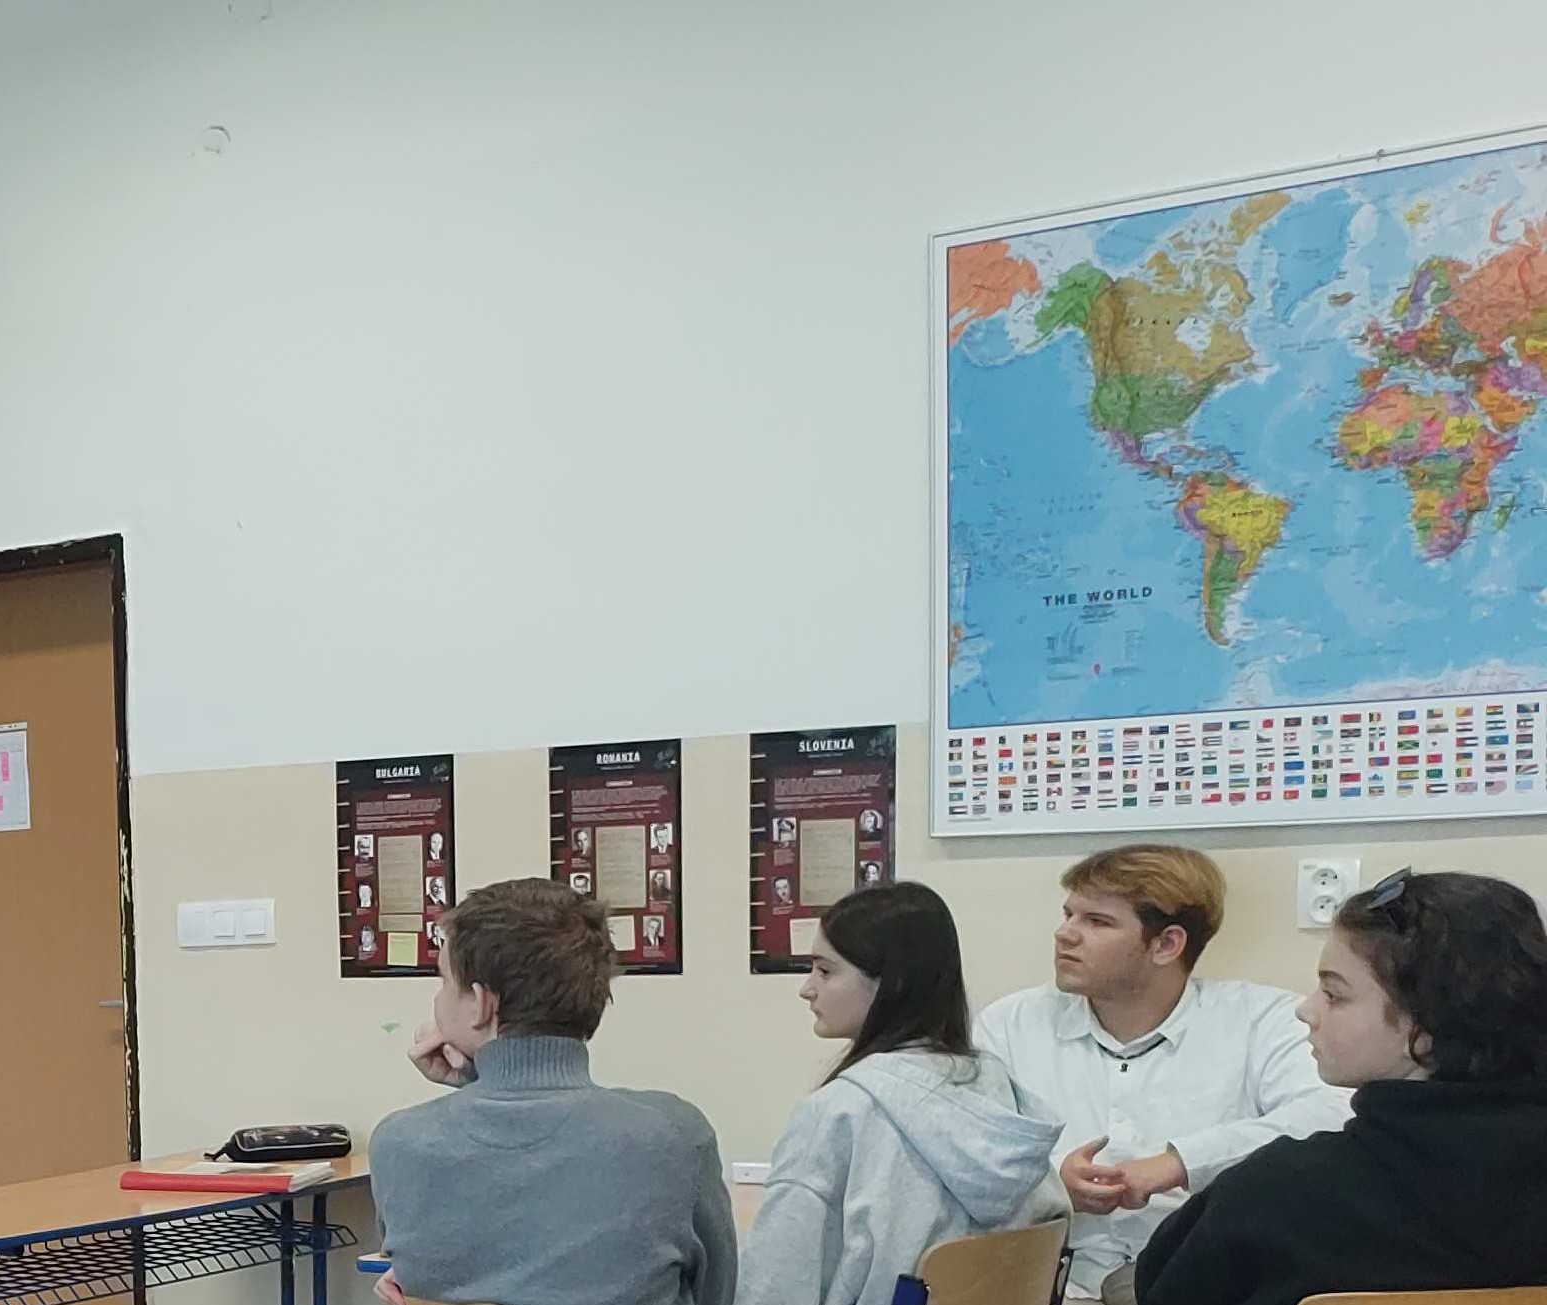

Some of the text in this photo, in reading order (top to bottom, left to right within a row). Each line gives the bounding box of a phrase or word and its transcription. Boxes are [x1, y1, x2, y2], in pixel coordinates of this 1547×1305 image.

[1043, 586, 1153, 607] THE WORLD
[798, 737, 855, 753] SLOVENIA
[375, 765, 421, 778] BULGARIA
